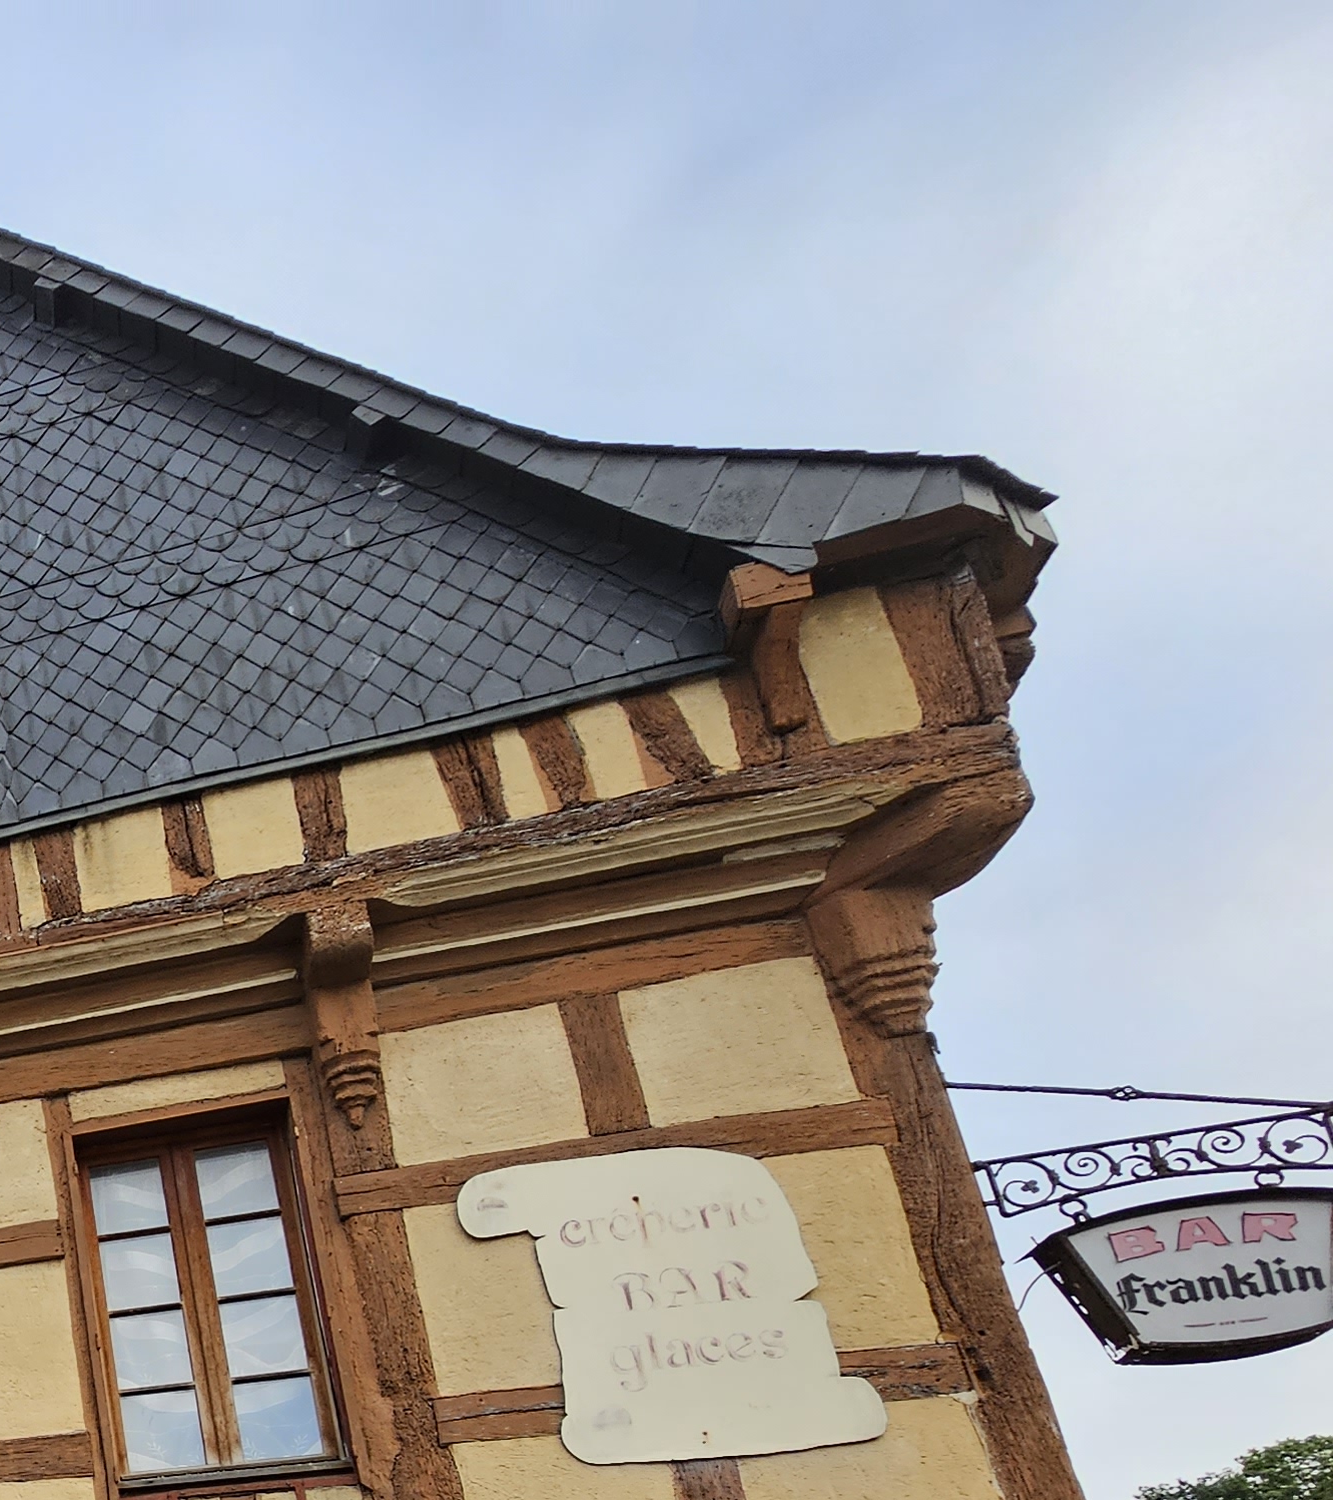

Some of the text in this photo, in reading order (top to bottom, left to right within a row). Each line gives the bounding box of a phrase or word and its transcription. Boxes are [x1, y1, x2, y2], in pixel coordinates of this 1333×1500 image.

[1107, 1211, 1298, 1263] BAR
[613, 1260, 756, 1311] BAR
[611, 1329, 788, 1392] glaces
